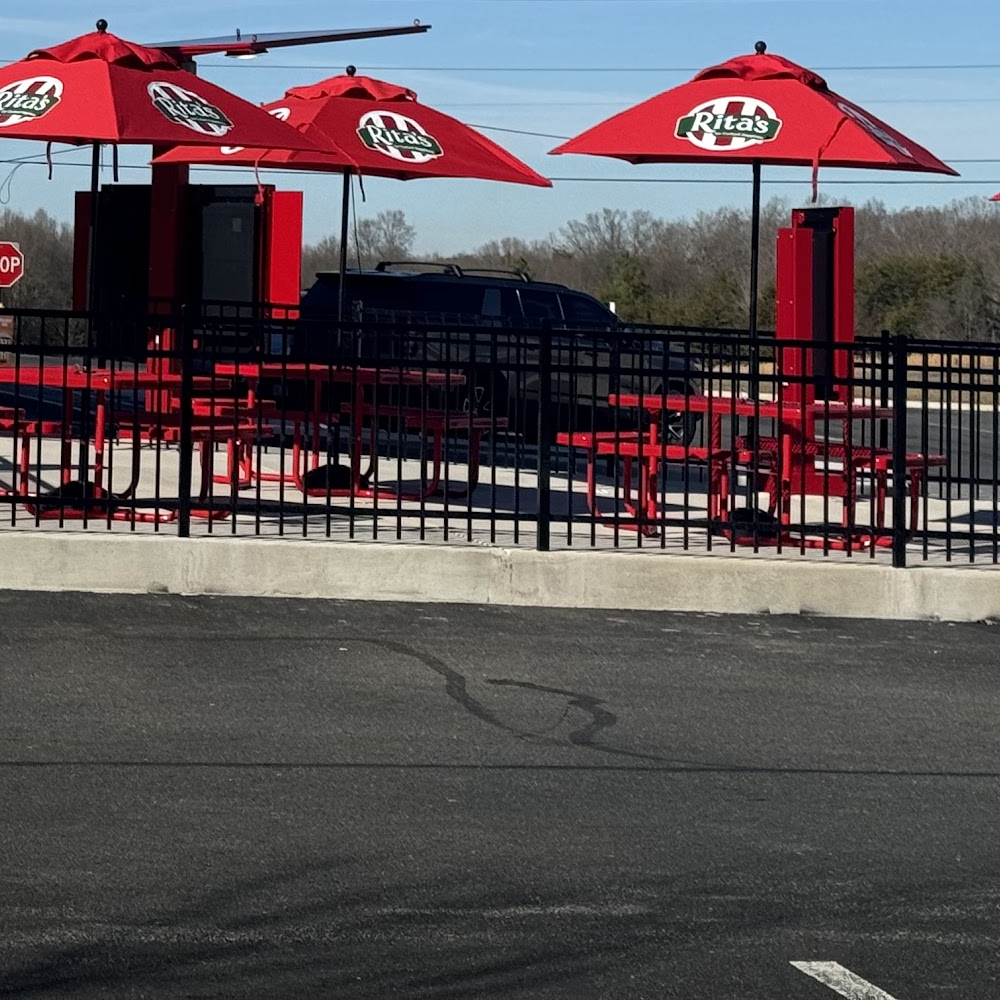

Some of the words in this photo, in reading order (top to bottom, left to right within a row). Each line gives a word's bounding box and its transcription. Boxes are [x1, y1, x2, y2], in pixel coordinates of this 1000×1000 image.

[155, 96, 220, 120] Rita's
[690, 111, 769, 134] Rita's
[364, 125, 432, 148] Rita's
